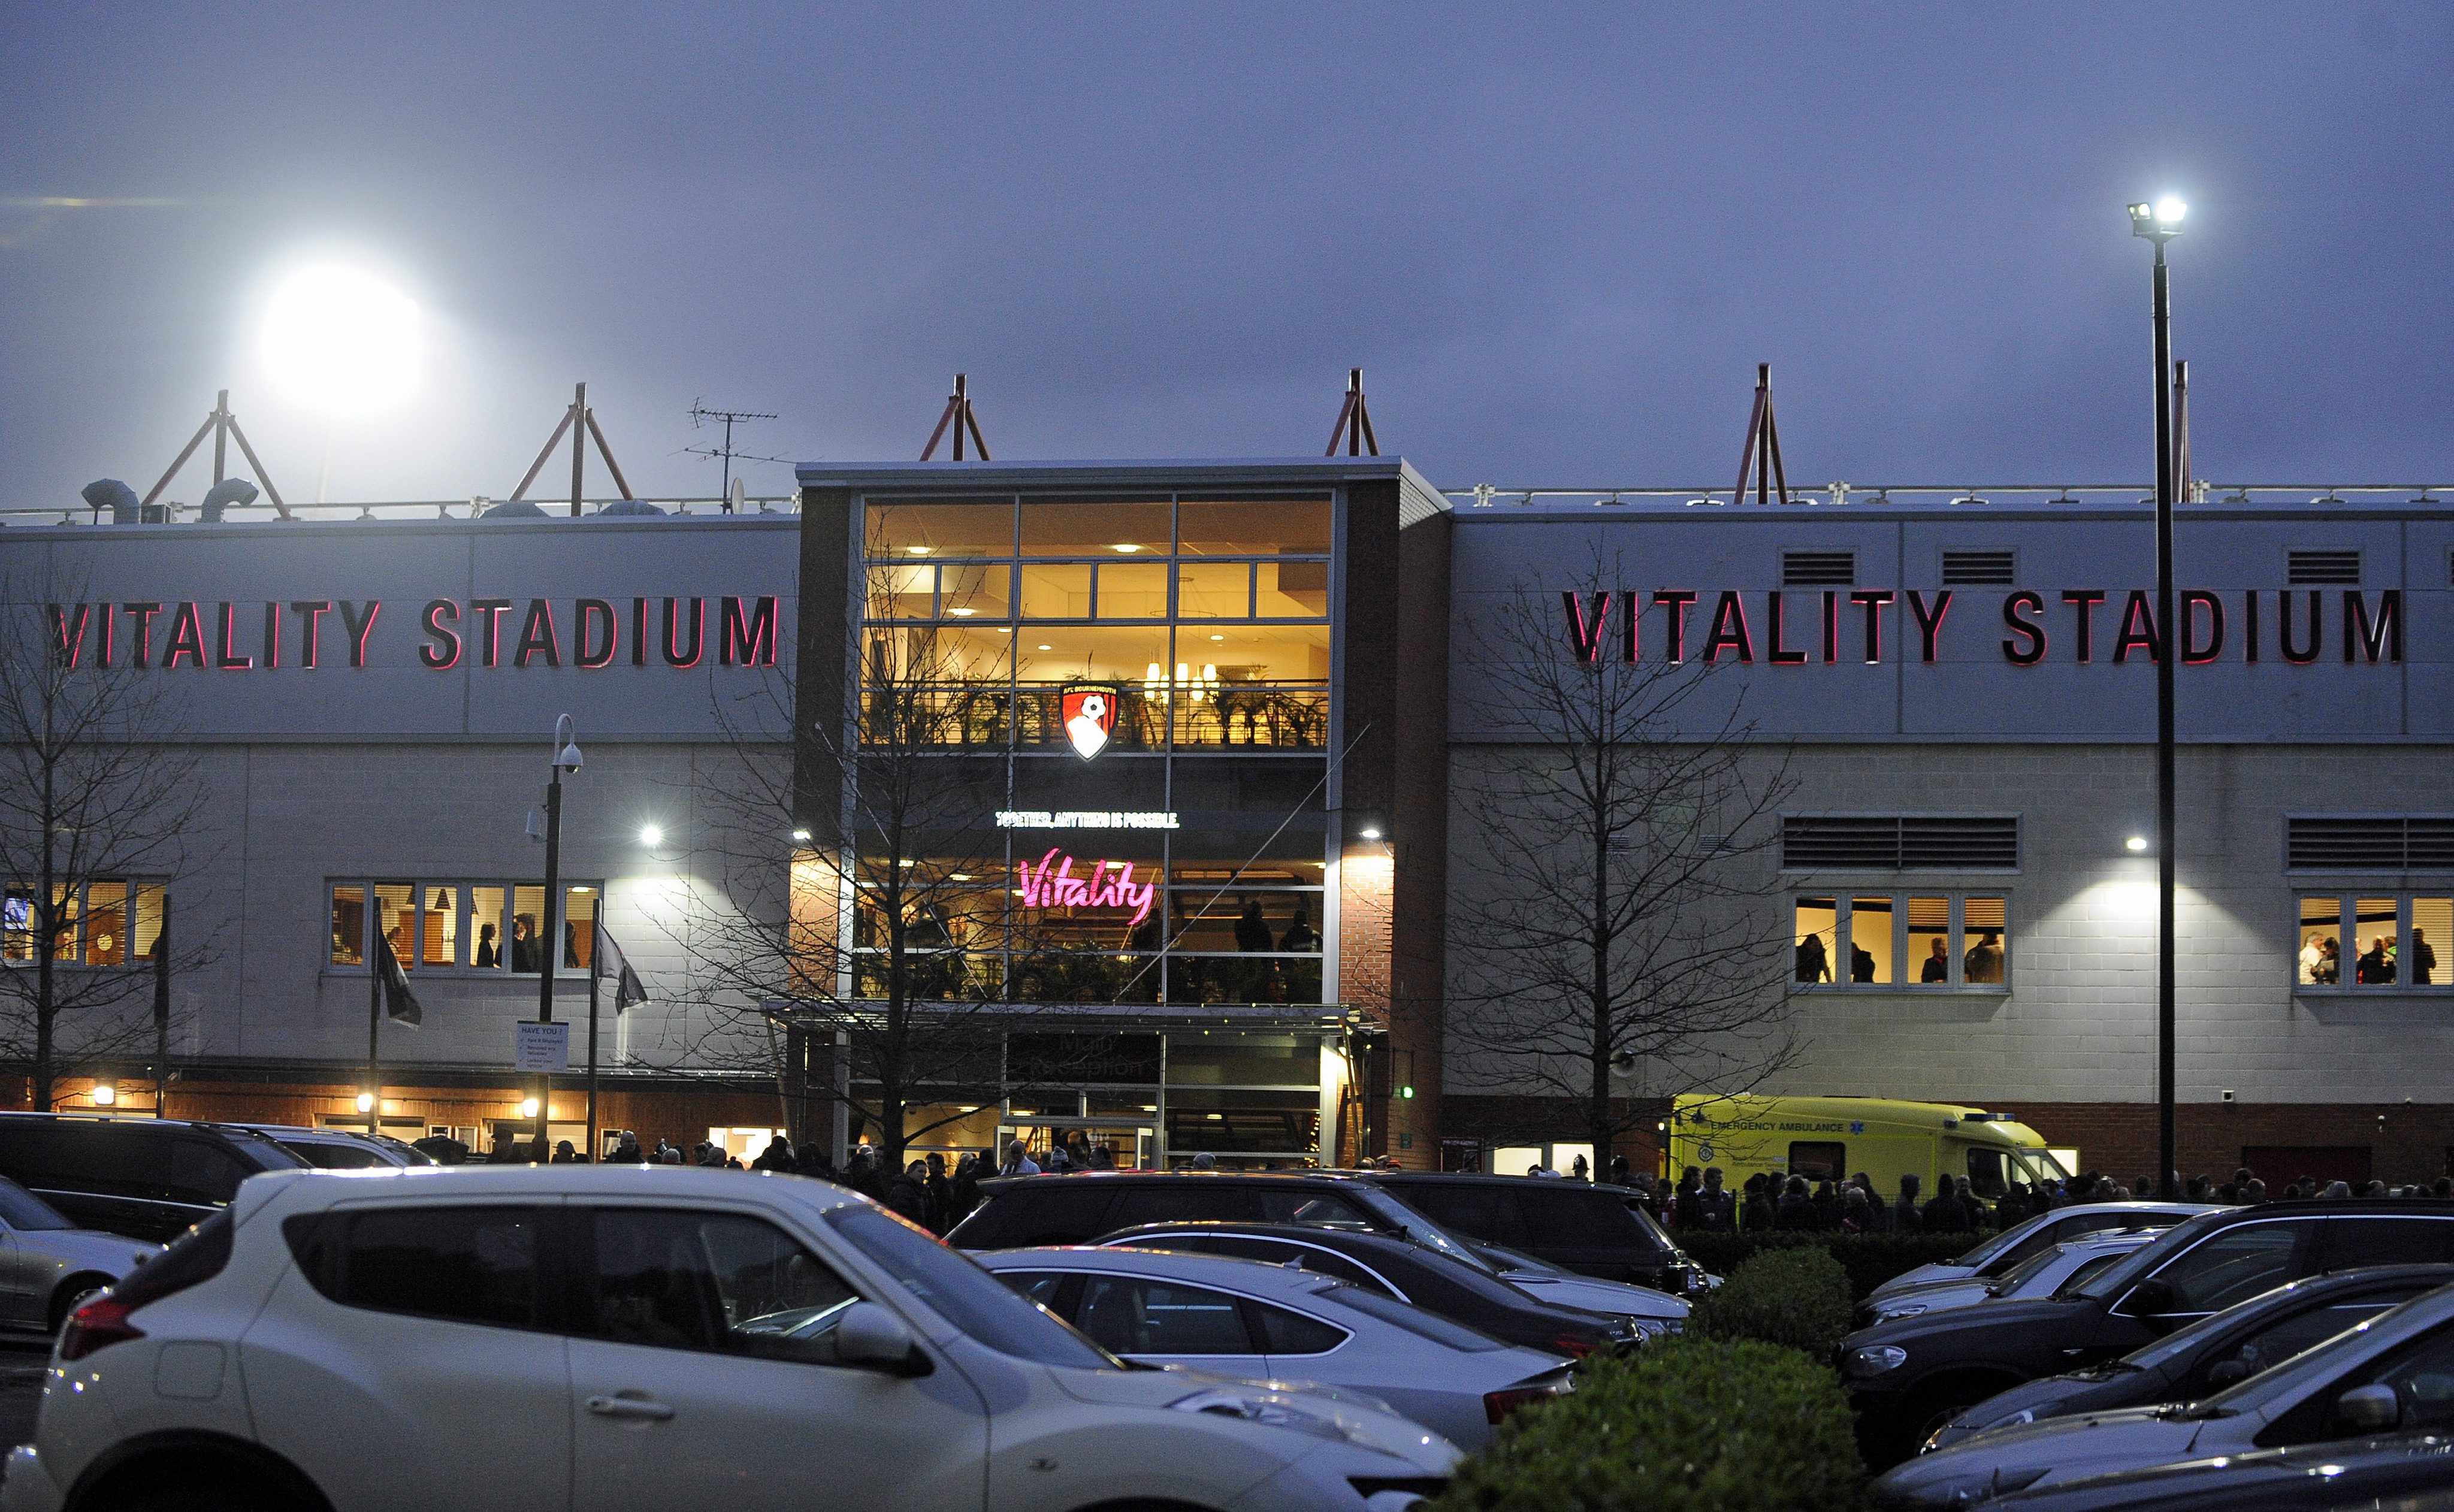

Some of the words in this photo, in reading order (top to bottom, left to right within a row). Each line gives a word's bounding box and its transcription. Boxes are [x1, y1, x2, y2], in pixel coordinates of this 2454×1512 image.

[49, 600, 380, 670] VITALITY
[418, 595, 778, 669] STADIUM
[1562, 590, 1953, 664] VITALITY
[2002, 589, 2404, 664] STADIUM
[1074, 685, 1116, 694] BOURNEMOUTH
[1054, 812, 1110, 828] ANYTHING
[1111, 812, 1123, 828] IS
[1020, 848, 1154, 926] Vitality
[1711, 1122, 1775, 1131] EMERGENCY
[1778, 1123, 1843, 1132] AMBULANCE
